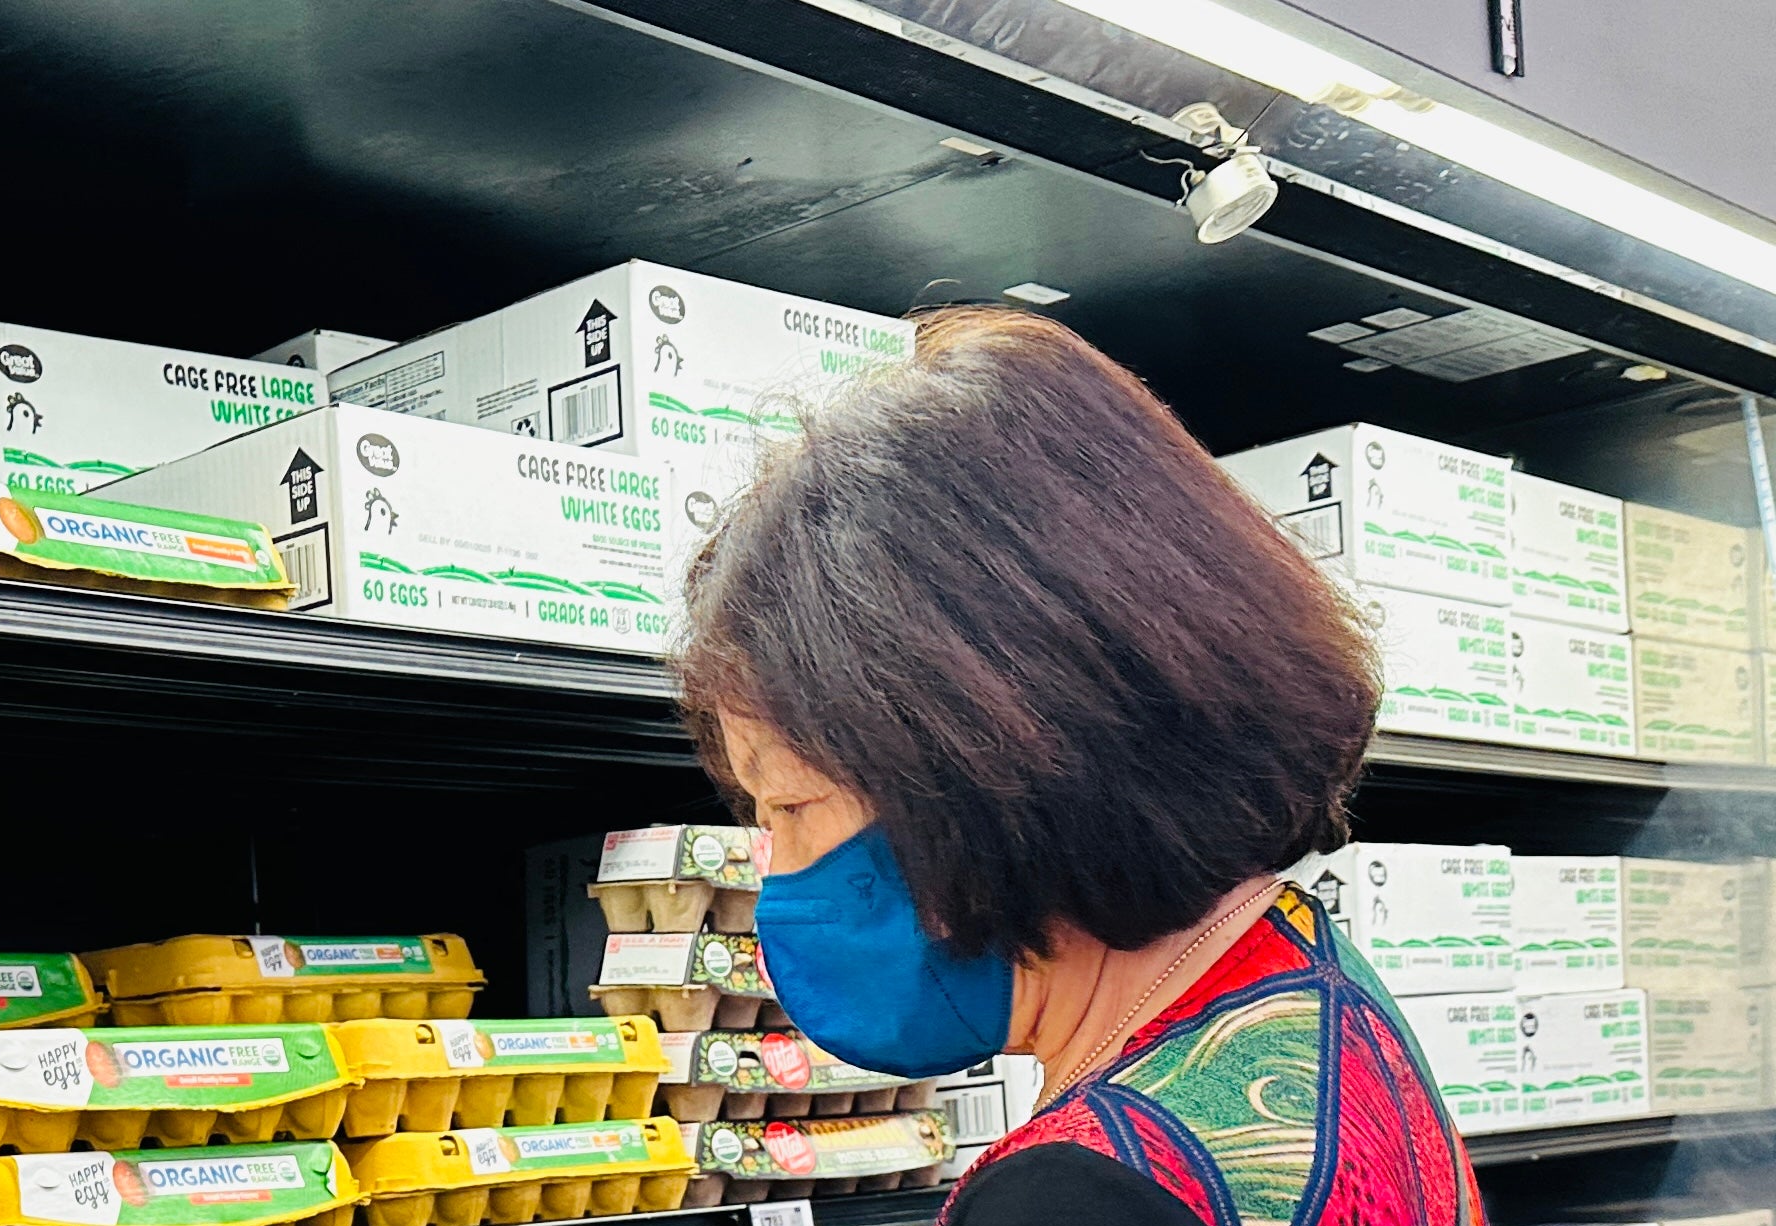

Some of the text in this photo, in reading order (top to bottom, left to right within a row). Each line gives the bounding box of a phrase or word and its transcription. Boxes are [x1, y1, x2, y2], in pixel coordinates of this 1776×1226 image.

[164, 363, 209, 391] CAGE
[215, 370, 257, 398] FREE
[262, 376, 315, 406] LARGE
[652, 417, 706, 444] 60 EGGS
[290, 467, 312, 482] THIS
[518, 454, 660, 499] CAGE FREE LARGE
[291, 481, 314, 499] SIDE
[296, 496, 311, 513] UP
[561, 496, 617, 525] WHITE
[624, 506, 662, 532] EGGS
[47, 516, 152, 547] ORGANIC
[152, 531, 182, 545] FREE
[363, 579, 383, 600] 60
[390, 584, 428, 607] EGGS
[38, 1041, 78, 1068] HAPPY
[229, 1046, 260, 1057] FREE
[497, 1037, 552, 1050] ORGANIC
[123, 1047, 229, 1069] ORGANIC
[43, 1061, 81, 1090] egg
[68, 1160, 105, 1188] HAPPY
[148, 1164, 248, 1188] ORGANIC
[247, 1162, 275, 1175] FREE
[74, 1179, 110, 1209] egg
